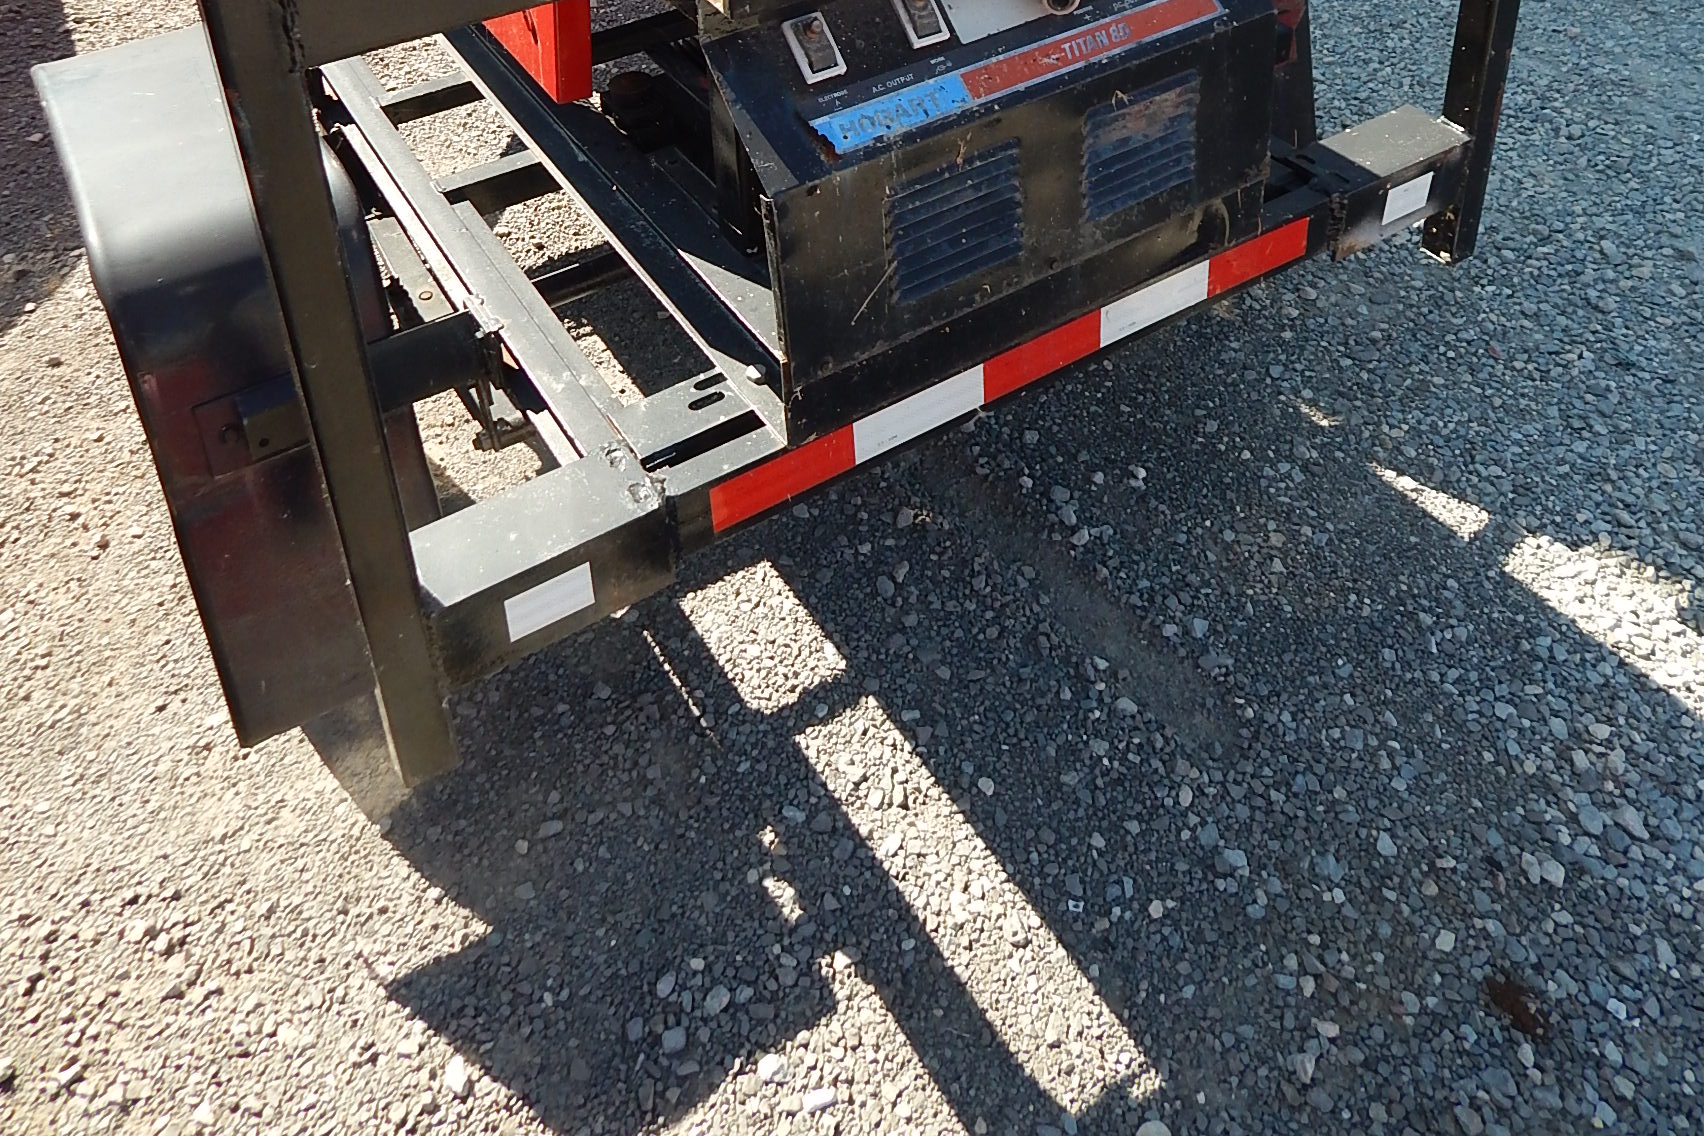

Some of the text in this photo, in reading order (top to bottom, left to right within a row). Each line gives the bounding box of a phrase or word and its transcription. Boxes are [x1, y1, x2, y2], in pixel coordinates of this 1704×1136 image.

[1060, 29, 1110, 60] TITAN
[886, 73, 914, 89] OUTPUT
[838, 90, 944, 138] HOBART
